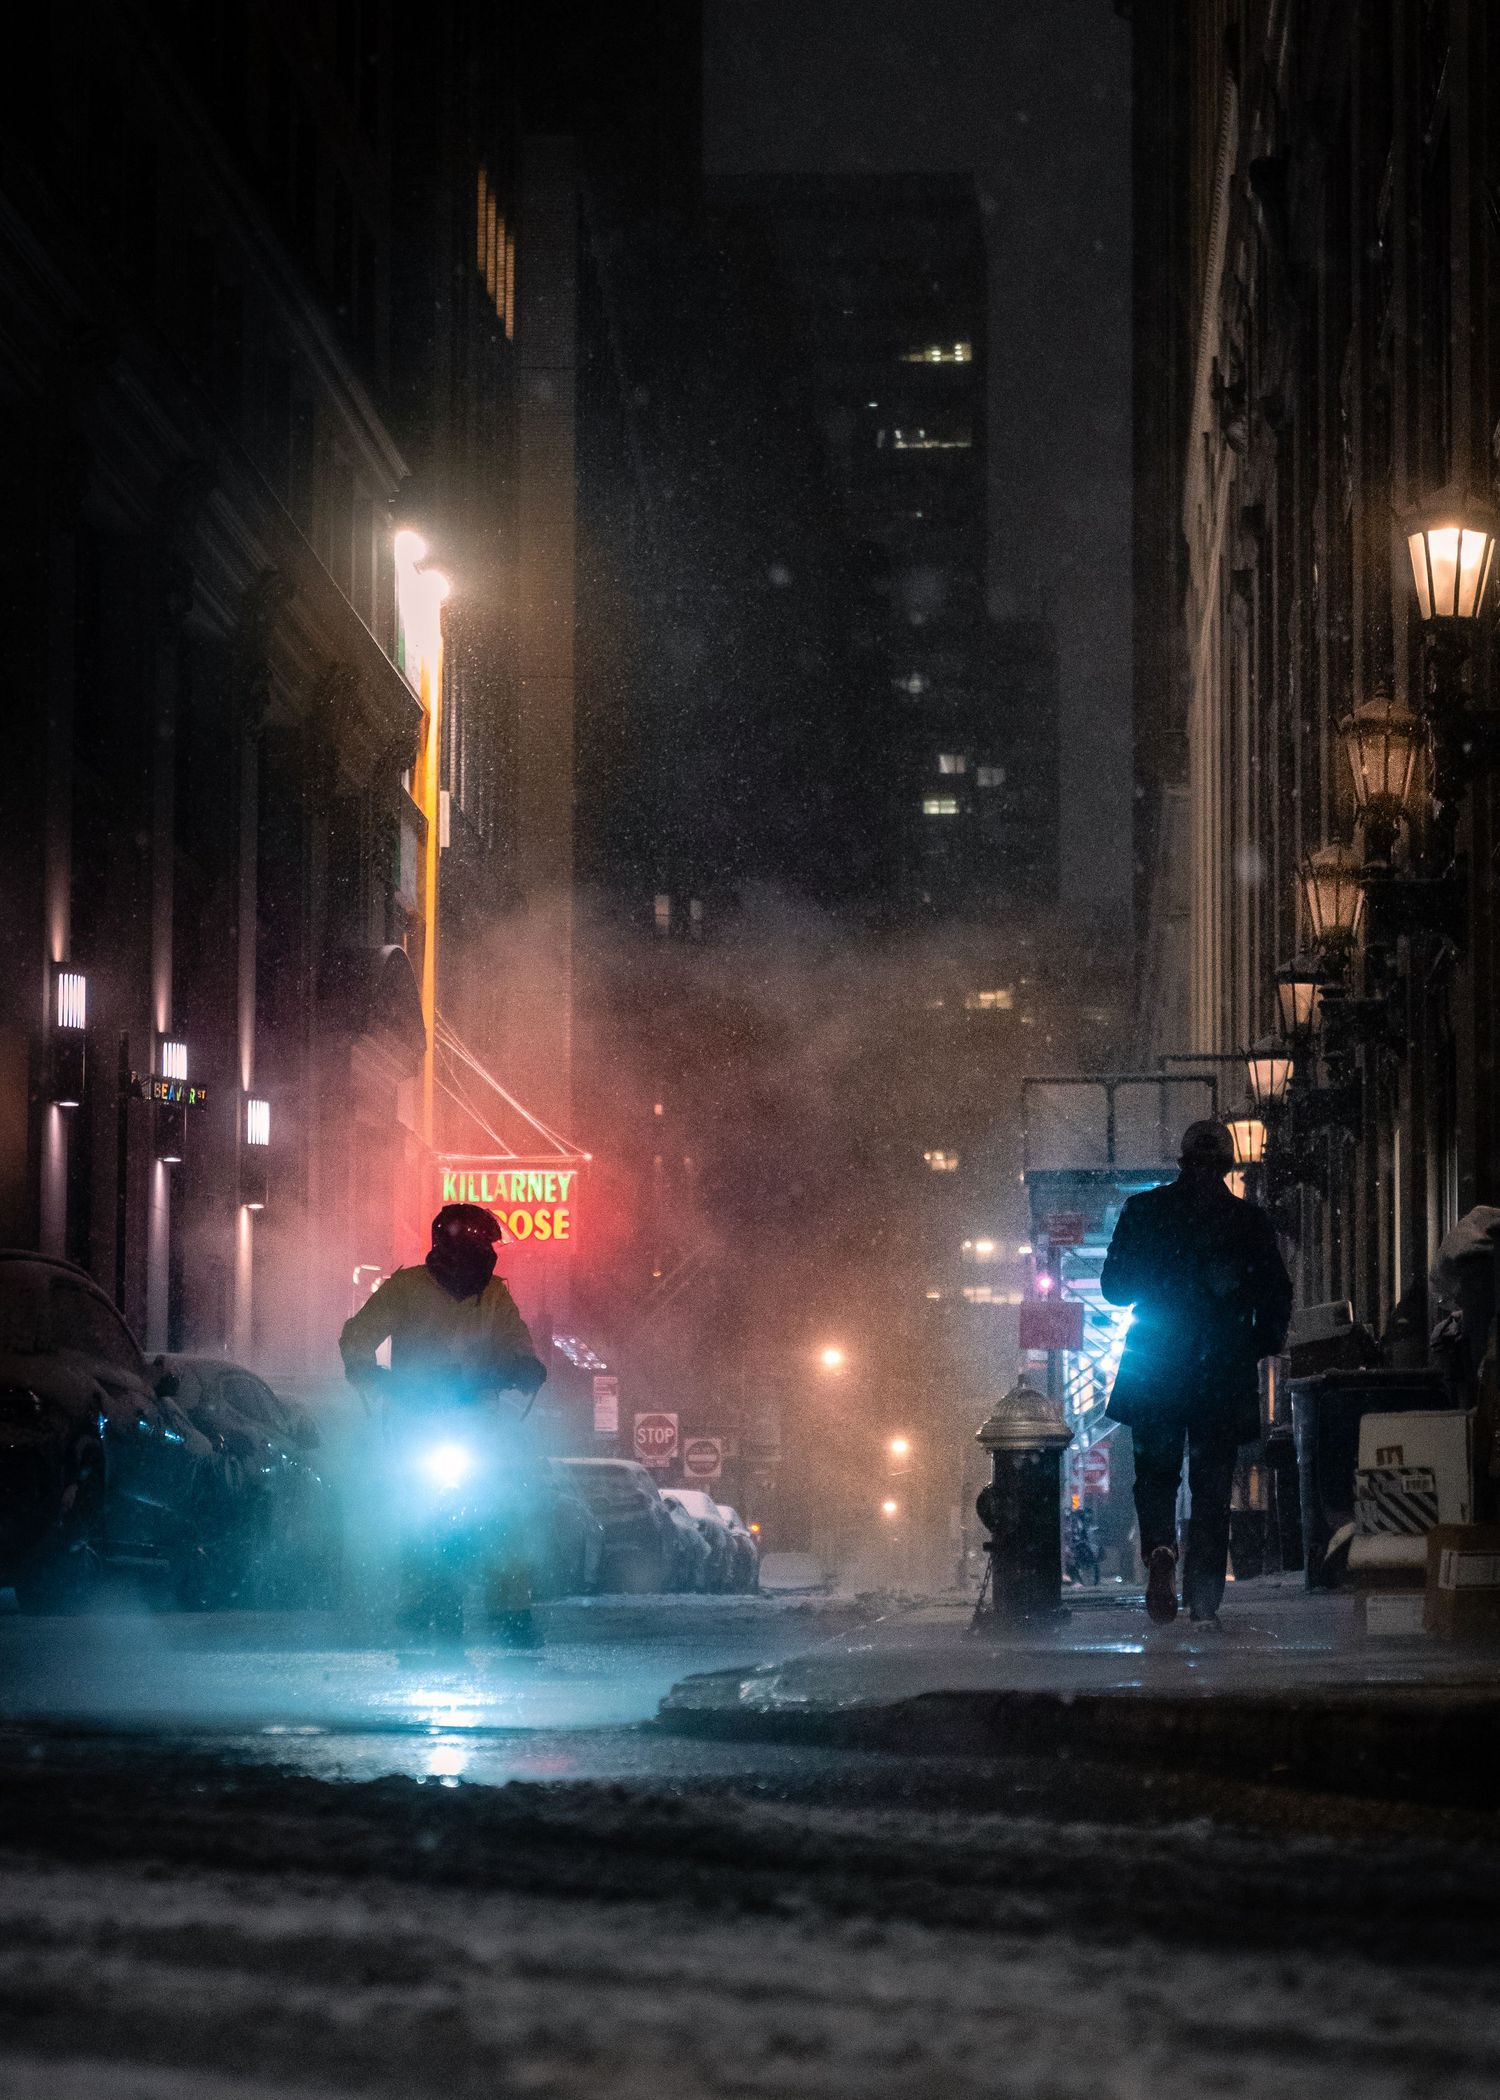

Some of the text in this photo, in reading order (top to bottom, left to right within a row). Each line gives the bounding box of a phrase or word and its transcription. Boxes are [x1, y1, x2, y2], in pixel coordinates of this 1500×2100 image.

[153, 1081, 206, 1105] BEAVR ST
[443, 1172, 572, 1203] KILLARNEY
[637, 1427, 674, 1443] STOP
